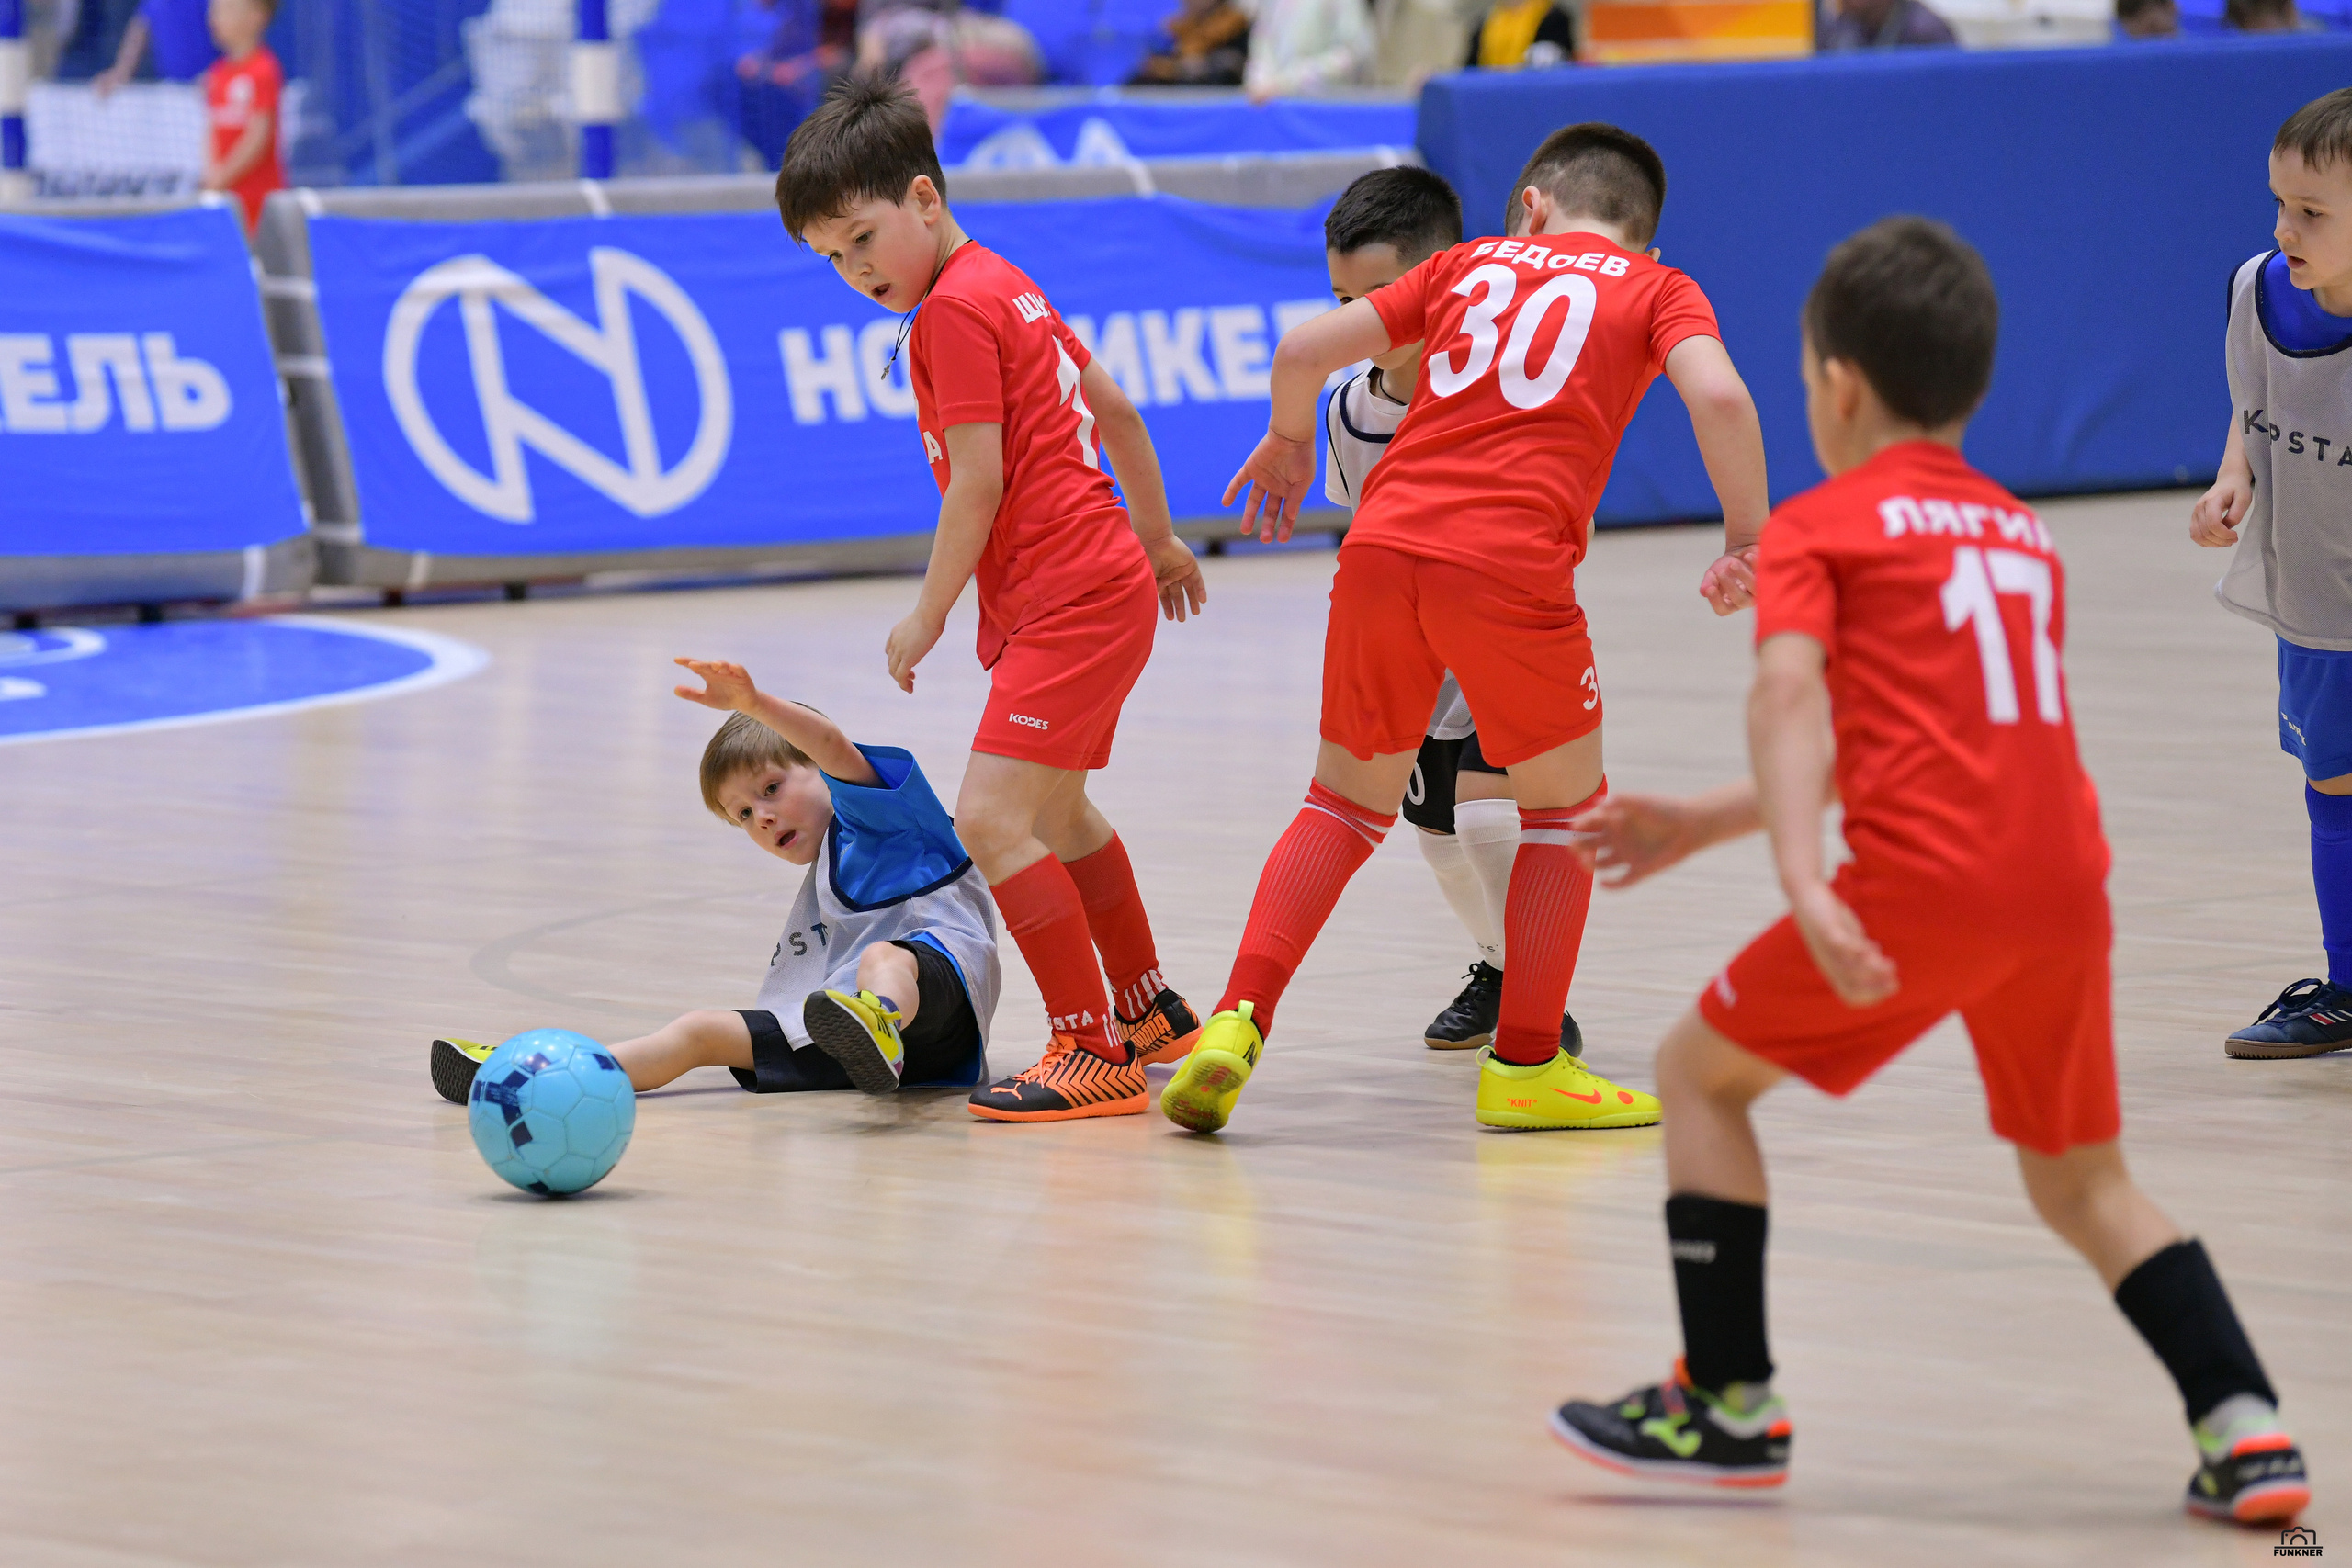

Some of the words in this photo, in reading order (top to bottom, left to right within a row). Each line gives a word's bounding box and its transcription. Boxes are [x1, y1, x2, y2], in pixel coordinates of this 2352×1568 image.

[778, 297, 1374, 425] НОИКЕ
[1429, 264, 1597, 410] 30
[1939, 545, 2063, 725] 17
[1009, 713, 1049, 730] KODES
